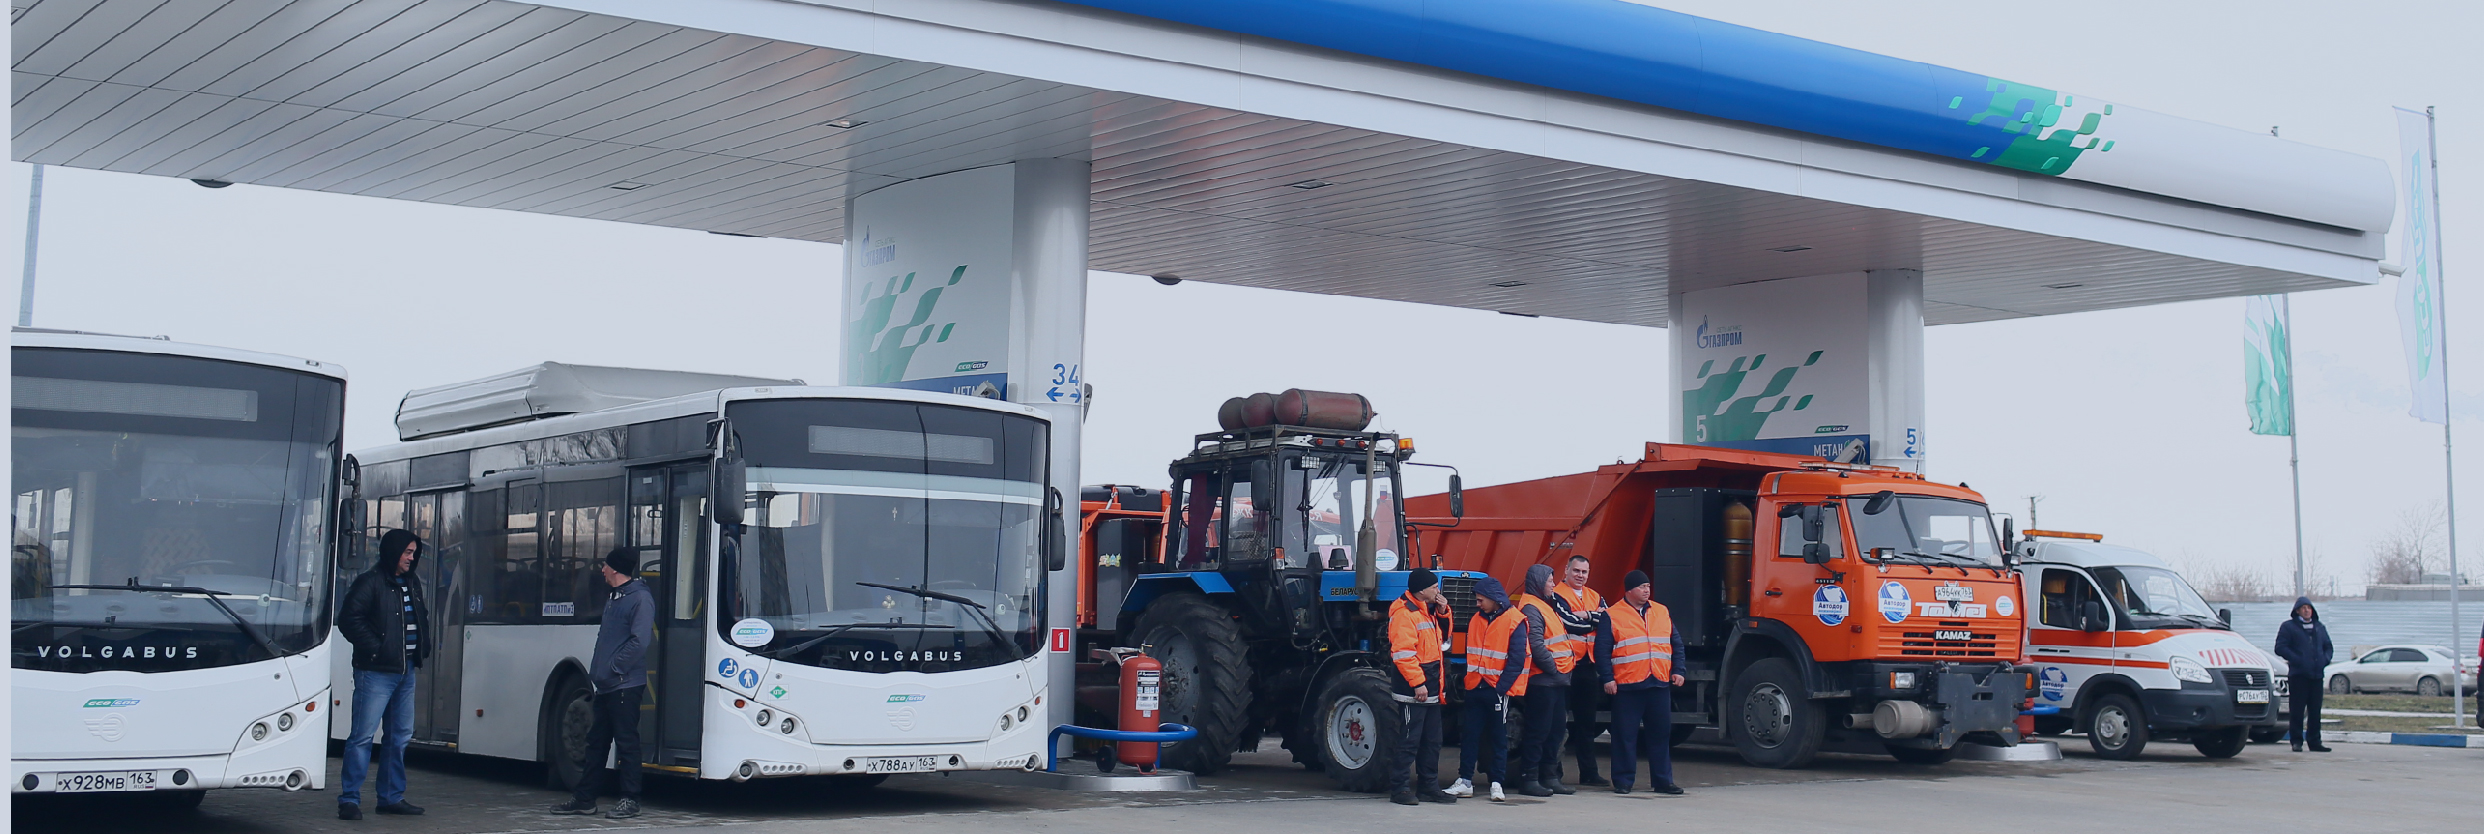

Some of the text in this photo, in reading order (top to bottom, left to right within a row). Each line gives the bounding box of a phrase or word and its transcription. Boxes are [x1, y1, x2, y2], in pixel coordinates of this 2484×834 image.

[1708, 331, 1742, 348] ГАЗПРОМ
[1696, 415, 1707, 443] 5
[1906, 427, 1917, 446] 5
[1818, 602, 1843, 611] Автодор
[1883, 599, 1906, 608] Автодор
[1935, 630, 1972, 640] KAMAZ
[38, 645, 197, 658] VOLGABUS
[850, 651, 962, 661] VOLGABUS
[2041, 680, 2065, 688] Автодор
[919, 757, 934, 766] 163
[129, 772, 153, 784] 163
